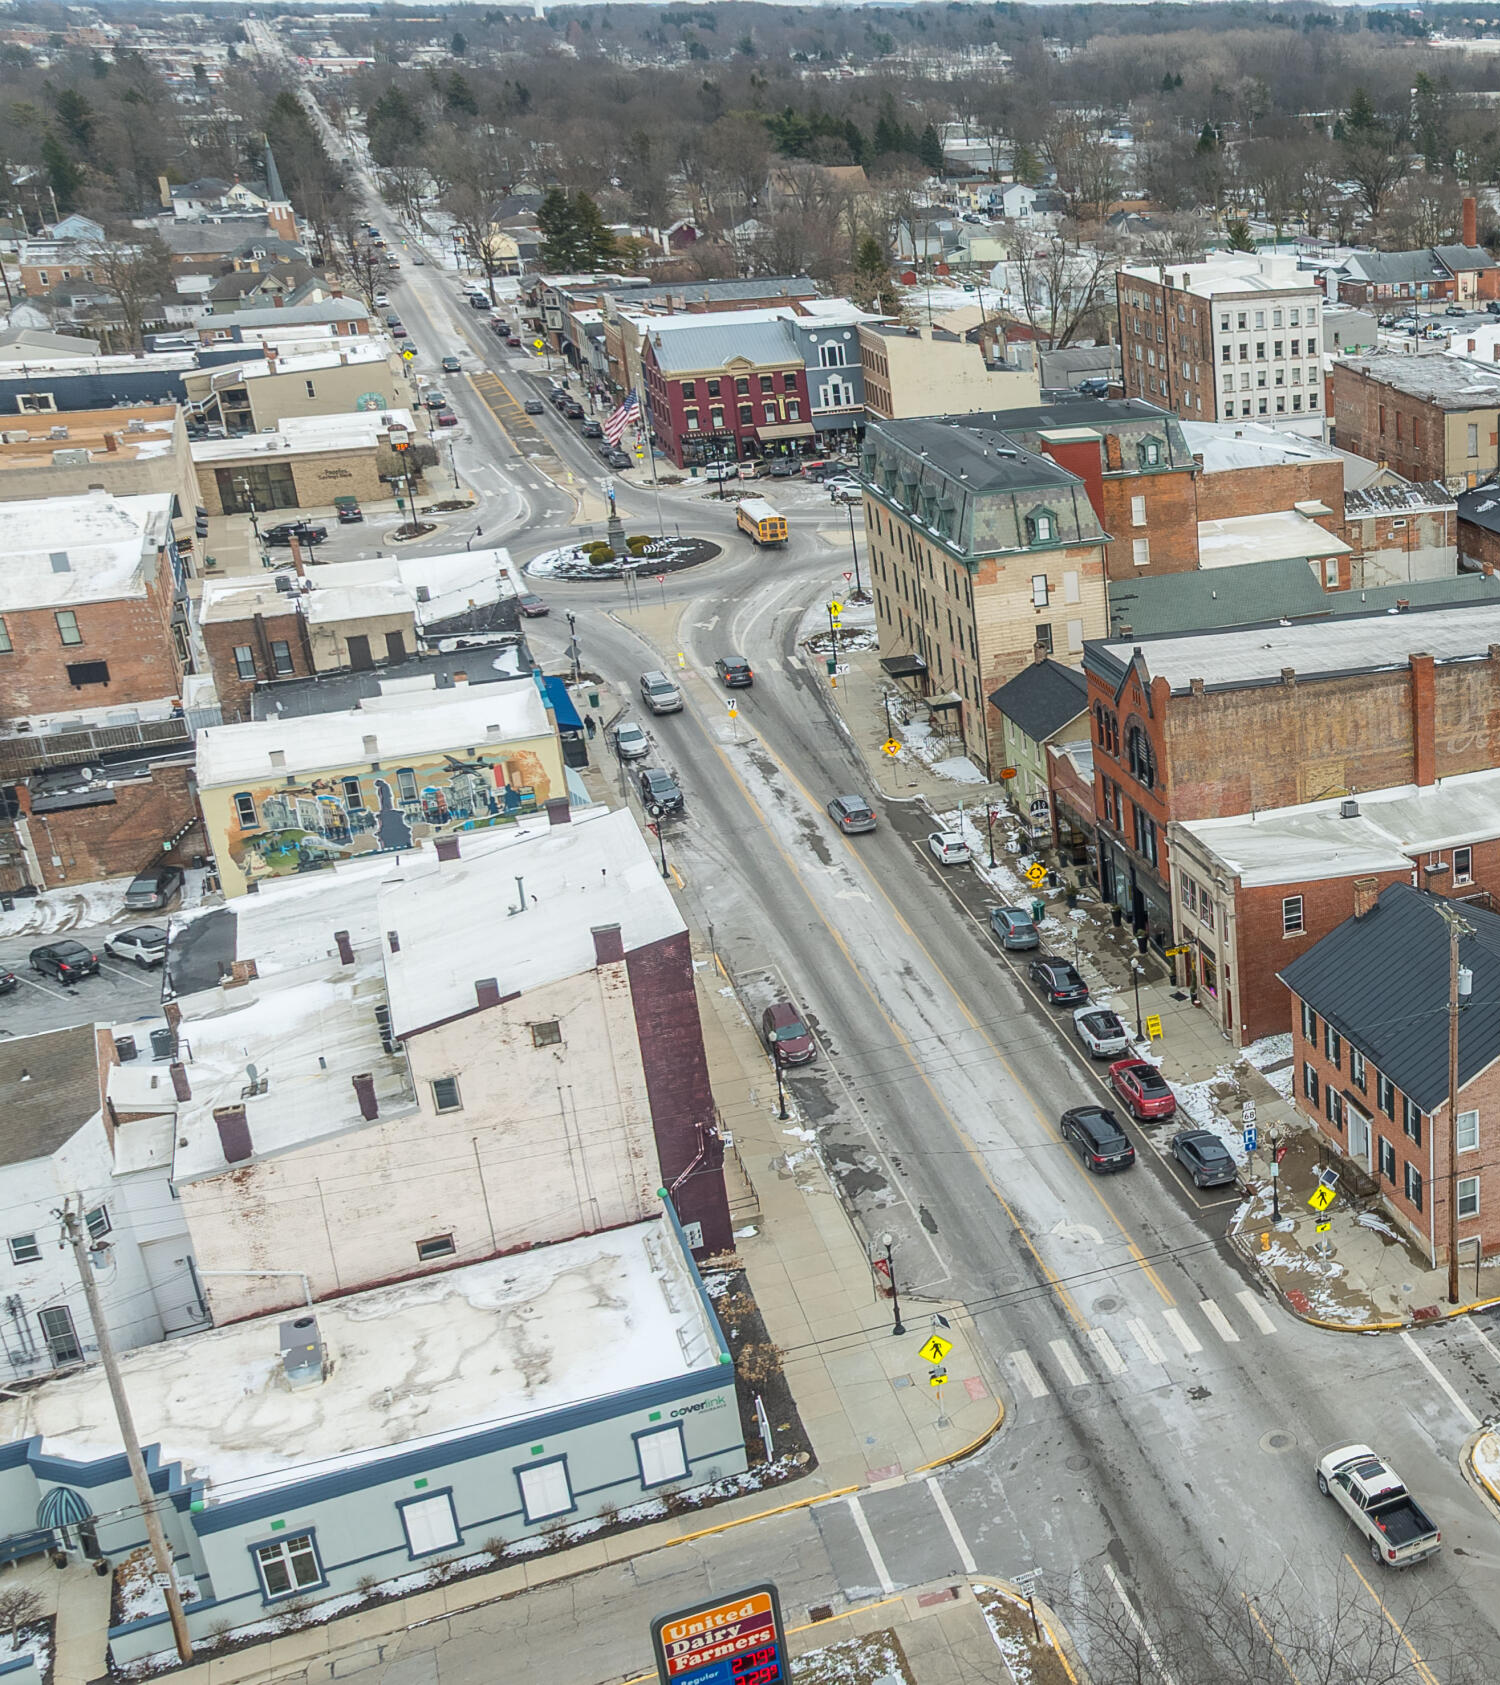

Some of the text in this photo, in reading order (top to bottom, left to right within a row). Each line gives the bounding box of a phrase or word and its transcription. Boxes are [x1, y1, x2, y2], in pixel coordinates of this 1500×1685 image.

[1244, 1101, 1254, 1109] JCT
[1244, 1111, 1255, 1120] 68
[1245, 1129, 1255, 1143] H
[669, 1602, 755, 1640] United
[671, 1623, 742, 1657] Dairy
[673, 1629, 772, 1671] Farmers
